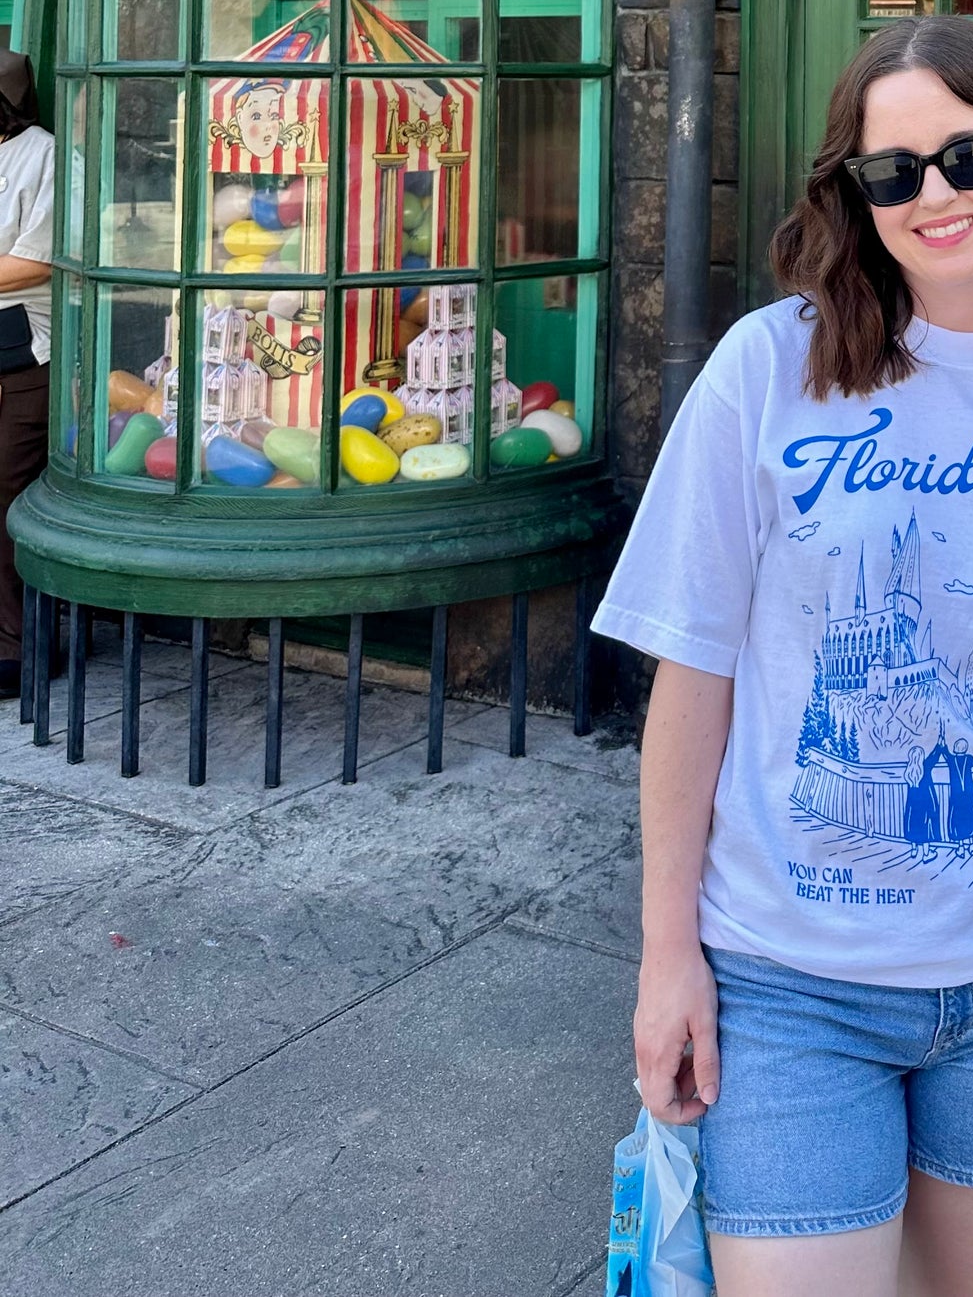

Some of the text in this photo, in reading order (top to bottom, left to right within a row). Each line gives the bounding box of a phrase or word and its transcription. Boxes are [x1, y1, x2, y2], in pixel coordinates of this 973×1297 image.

[252, 326, 297, 368] BOTTS
[787, 861, 852, 884] YOU CAN
[796, 882, 916, 904] BEAT THE HEAT
